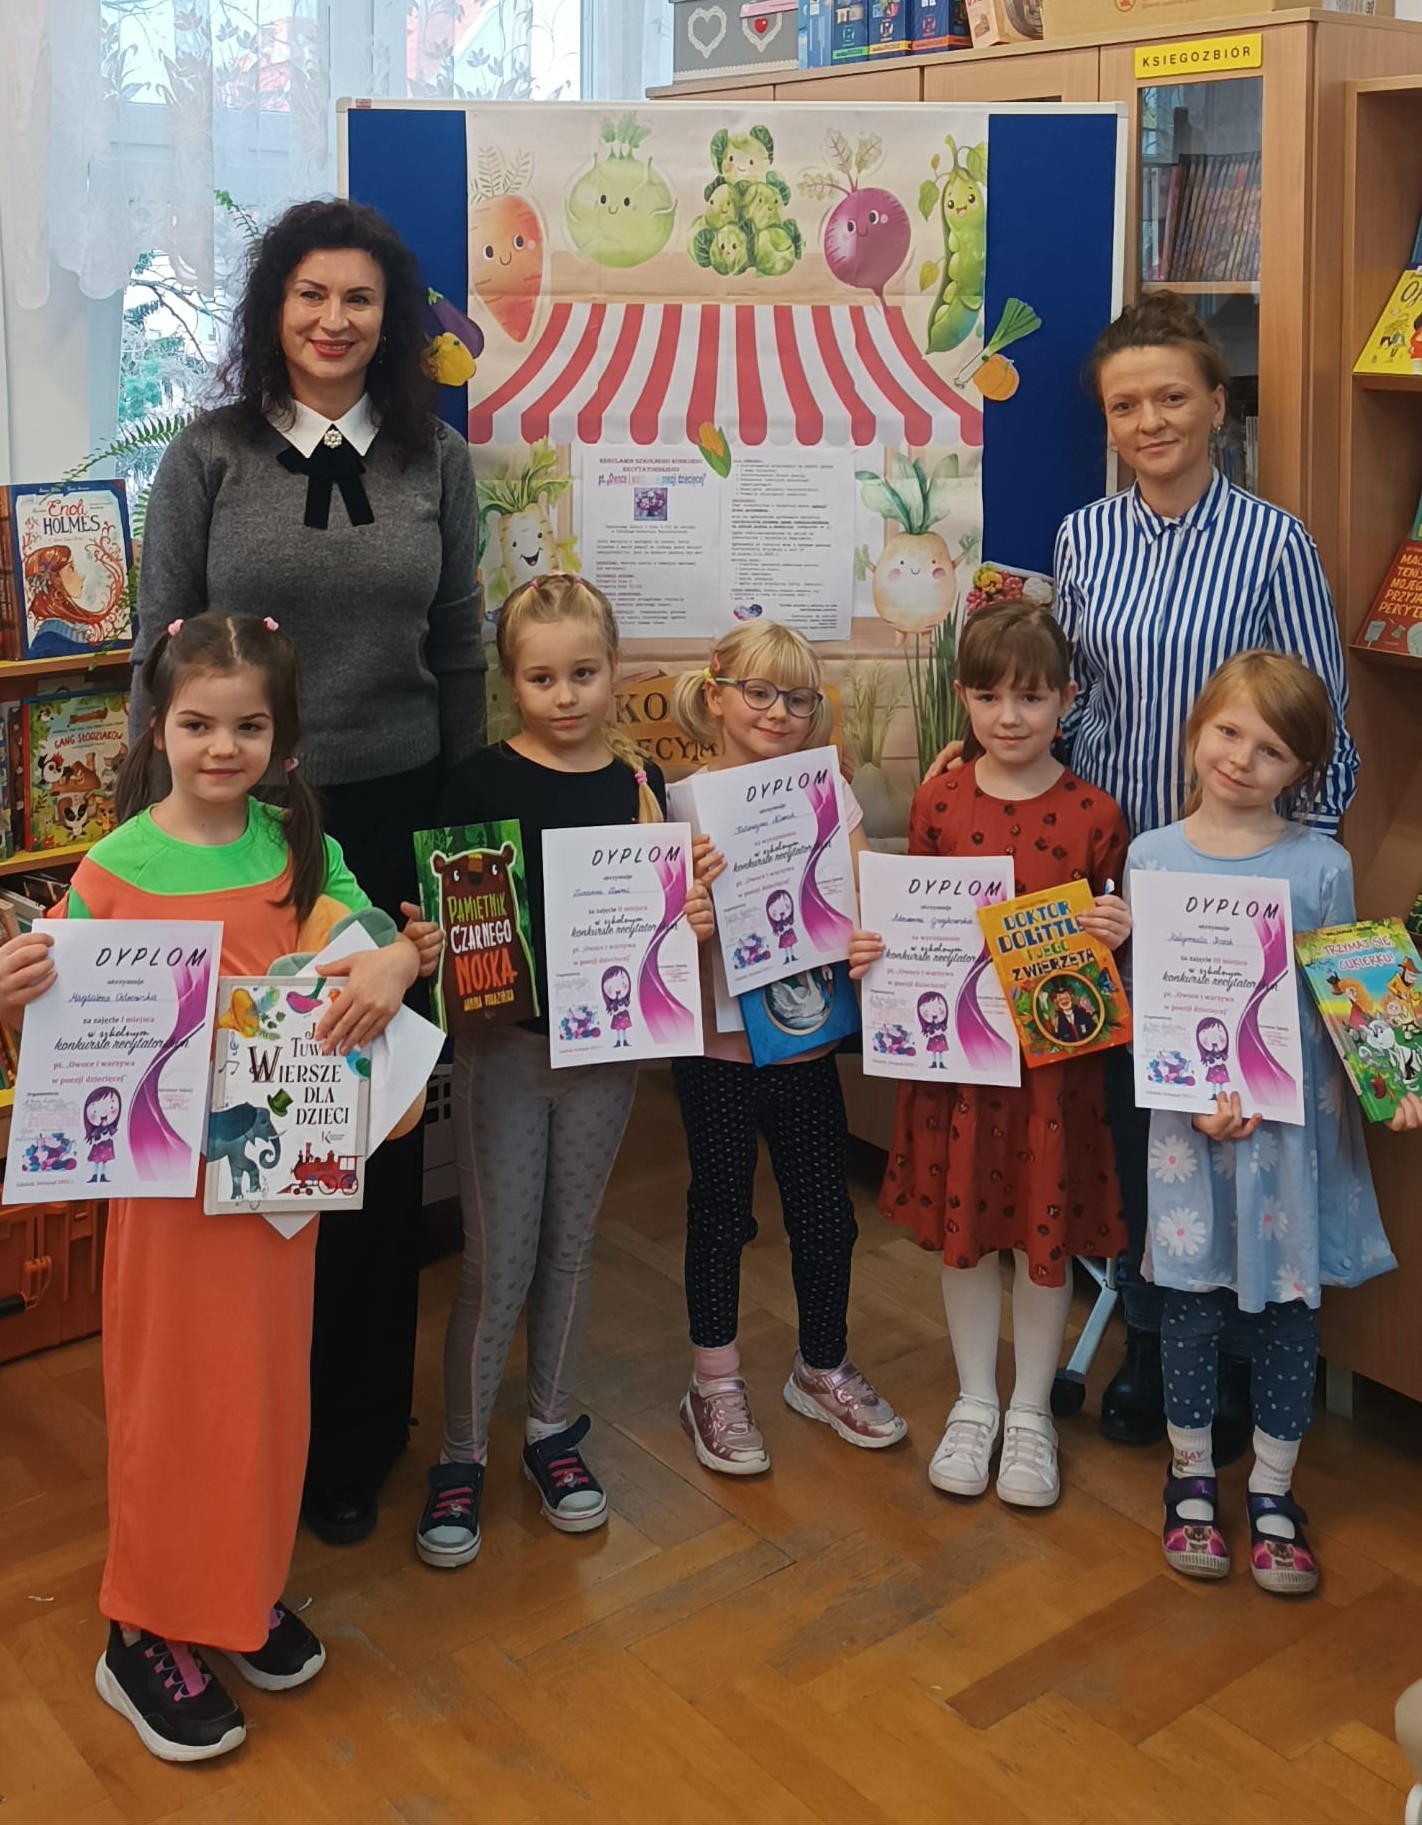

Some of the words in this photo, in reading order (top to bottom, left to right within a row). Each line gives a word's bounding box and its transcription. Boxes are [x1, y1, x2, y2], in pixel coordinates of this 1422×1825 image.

[43, 514, 101, 536] HOLMES
[1384, 588, 1422, 604] PRZYJA
[746, 768, 828, 803] DYPLOM
[591, 845, 681, 867] DYPLOM
[908, 878, 1002, 897] DYPLOM
[1003, 901, 1072, 931] DOKTOR
[1185, 896, 1280, 919] DYPLOM
[450, 918, 512, 954] CZARNEGO
[95, 947, 207, 967] DYPLOM
[1325, 939, 1369, 955] TRZYMAJ
[1339, 953, 1394, 970] CUKIERKU!
[454, 947, 518, 997] NOSKA
[54, 1037, 111, 1051] konkursie
[100, 1025, 149, 1043] szkolnym
[291, 1036, 337, 1057] TUW
[247, 1045, 342, 1083] WIERSZE
[304, 1086, 335, 1104] DLA
[296, 1107, 349, 1126] DZIECI
